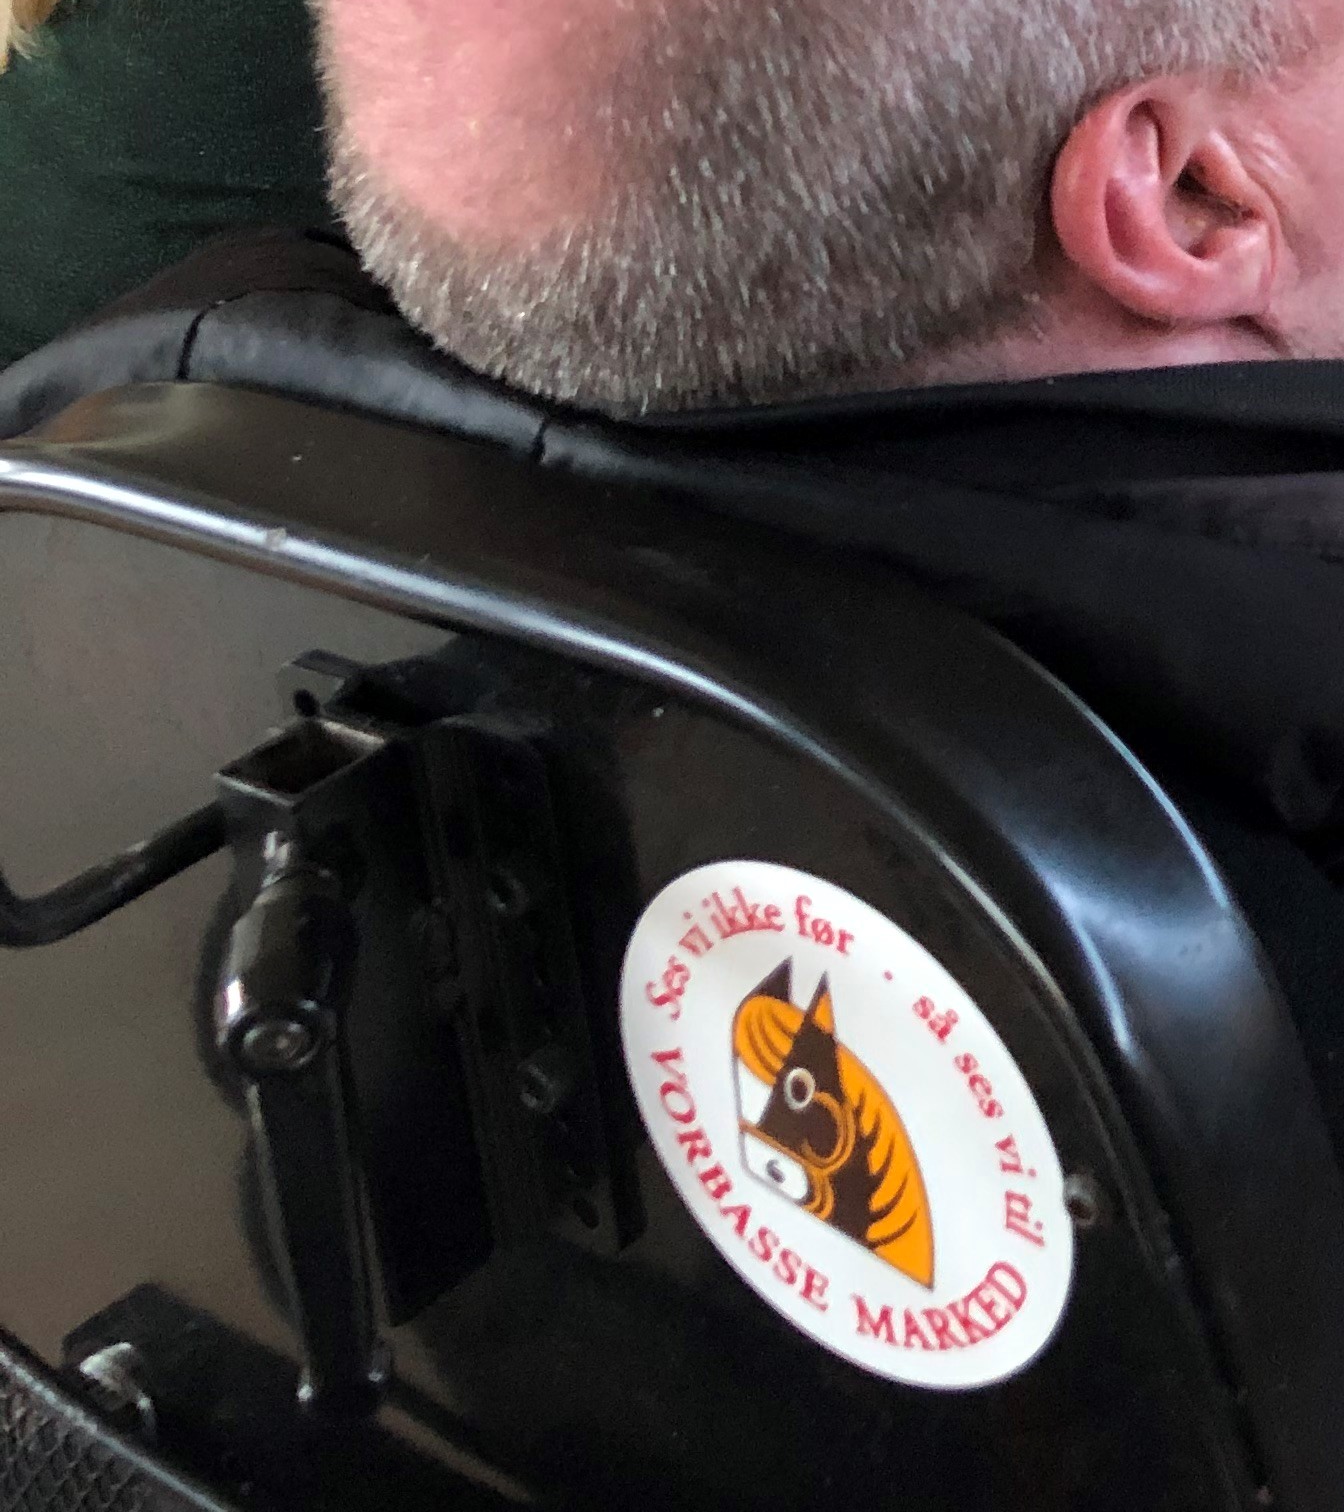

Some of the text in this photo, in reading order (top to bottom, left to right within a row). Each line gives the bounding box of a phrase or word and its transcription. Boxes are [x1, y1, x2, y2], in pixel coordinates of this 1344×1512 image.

[678, 912, 714, 957] vi
[702, 886, 785, 939] ikke
[795, 894, 855, 956] før
[911, 995, 959, 1045] så
[953, 1052, 1004, 1118] ses
[995, 1135, 1037, 1178] vi
[650, 1047, 1028, 1351] VORBASSE MARKED
[1005, 1190, 1046, 1248] til
